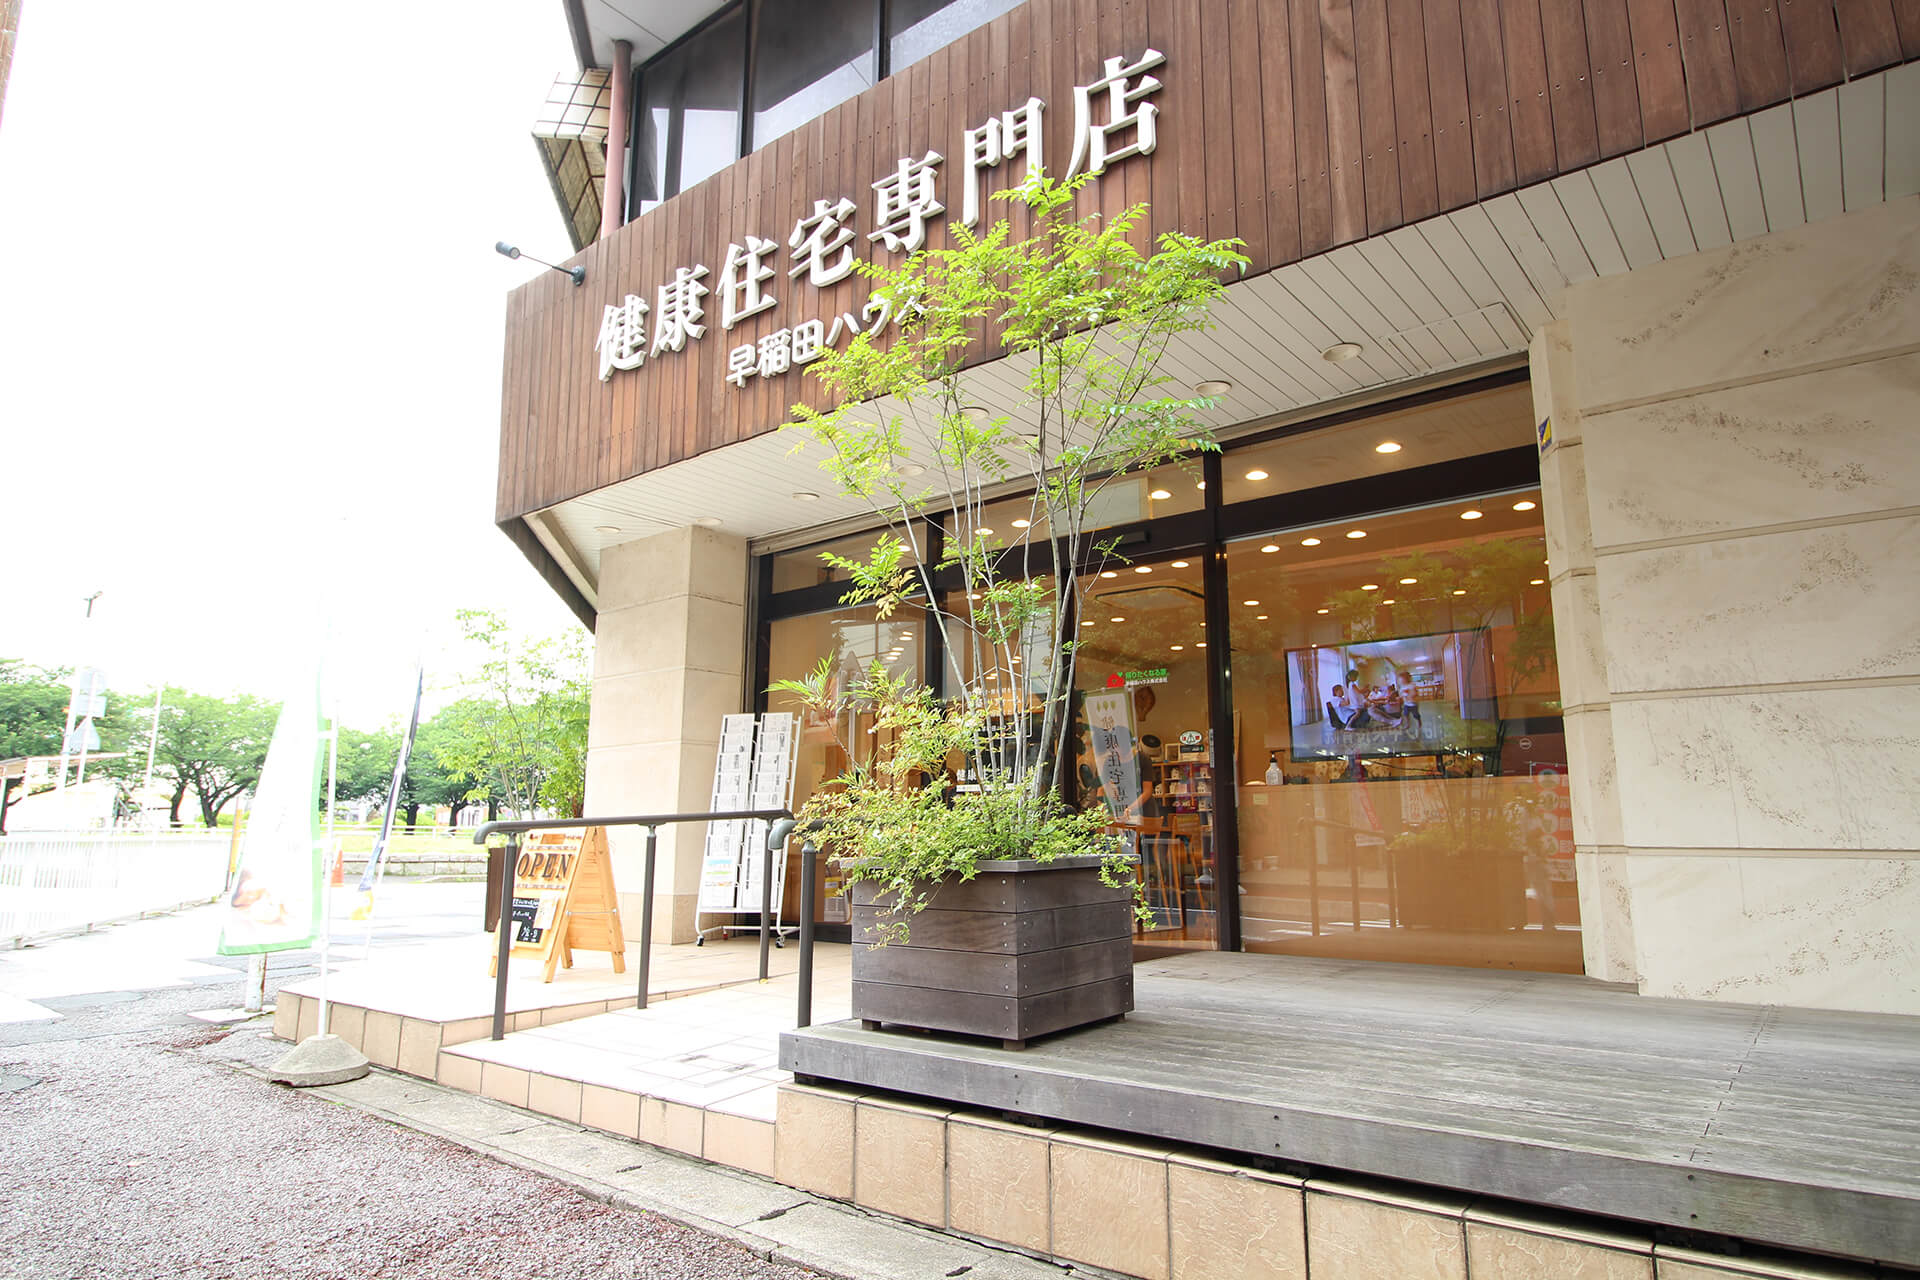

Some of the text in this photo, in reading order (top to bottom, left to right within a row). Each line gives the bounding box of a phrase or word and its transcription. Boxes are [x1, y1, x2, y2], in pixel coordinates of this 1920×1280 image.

[596, 48, 1166, 382] 健康住宅専門店
[517, 852, 573, 879] OPEN
